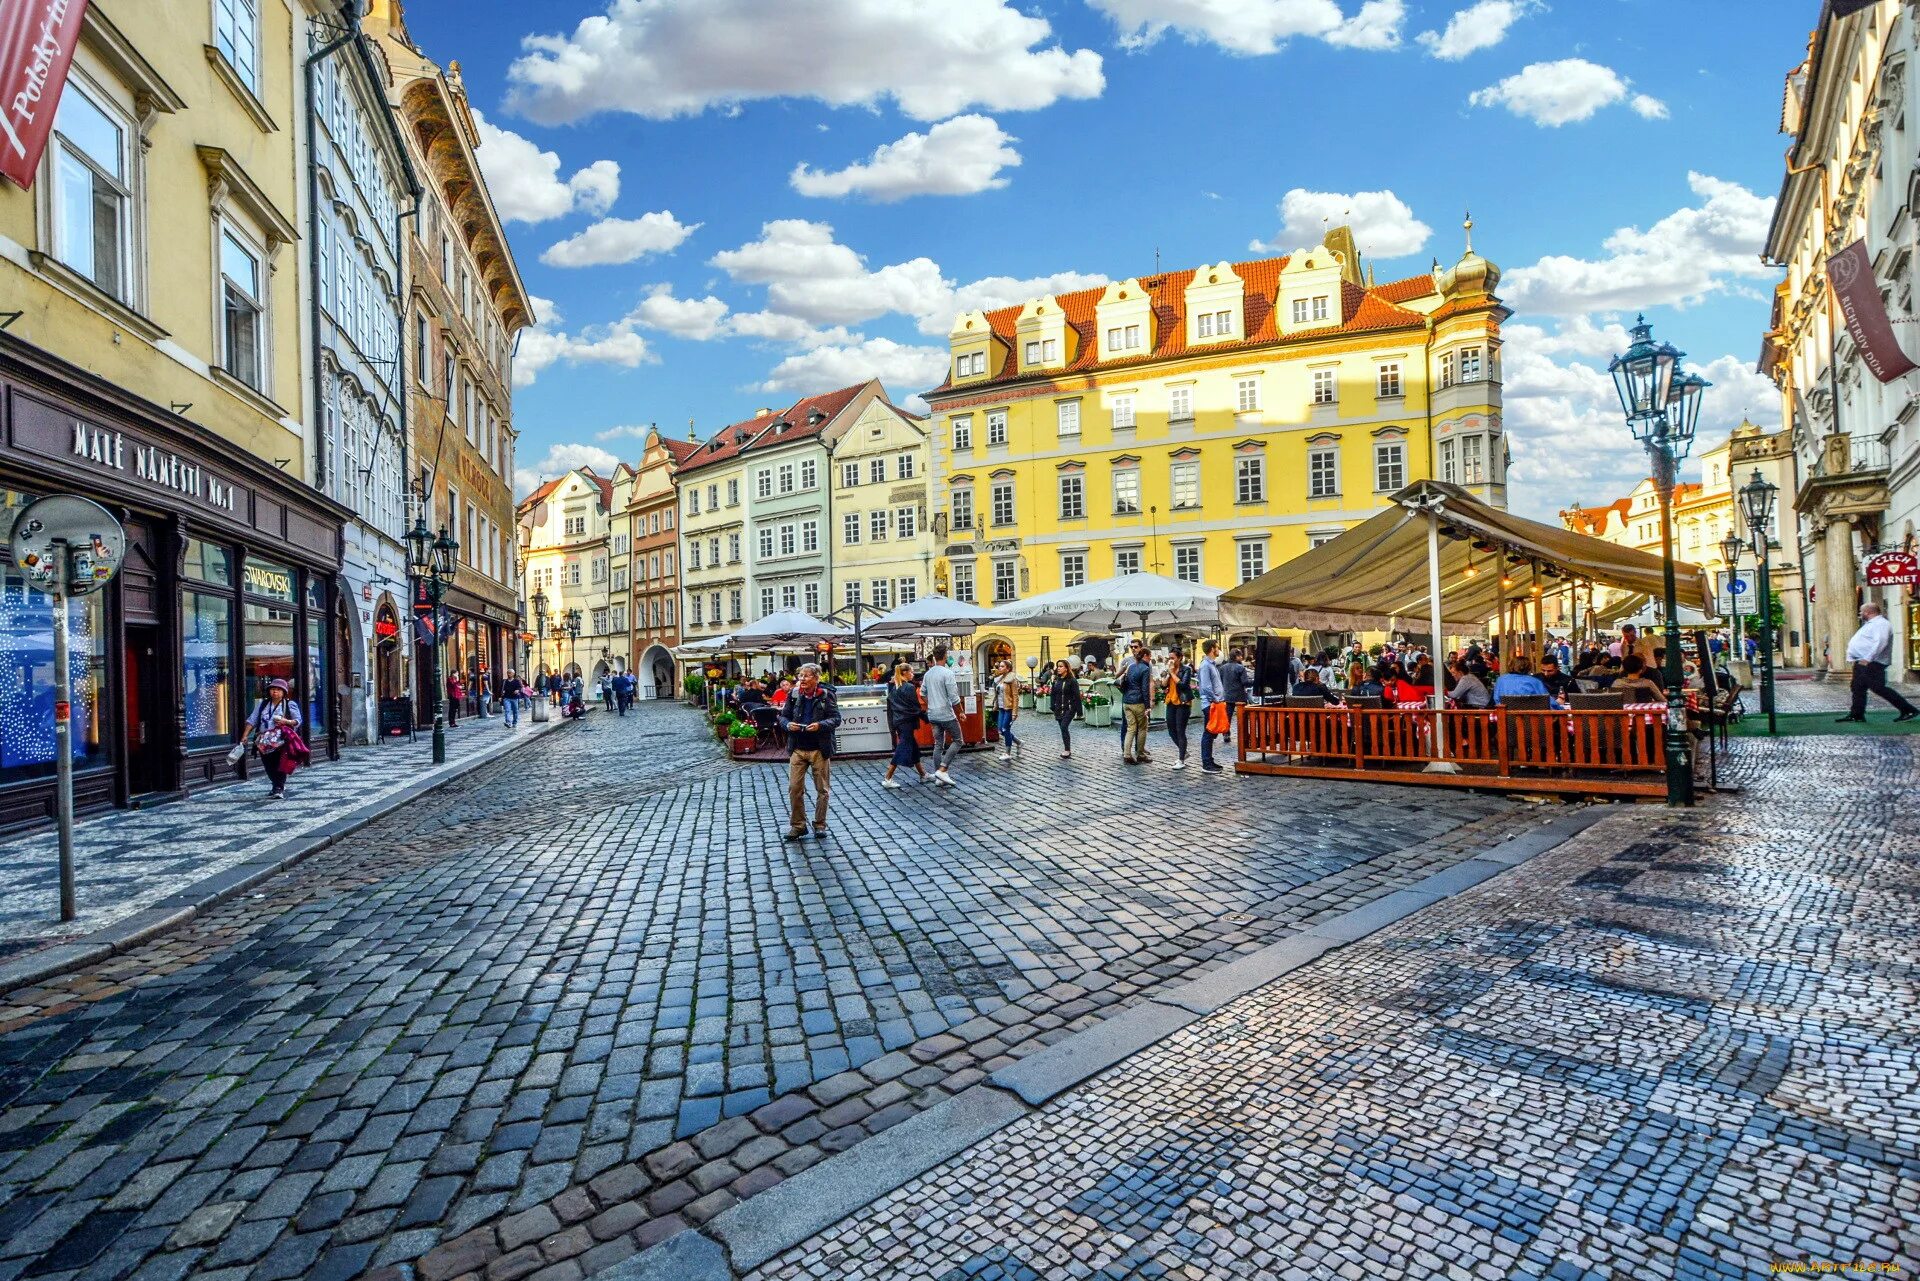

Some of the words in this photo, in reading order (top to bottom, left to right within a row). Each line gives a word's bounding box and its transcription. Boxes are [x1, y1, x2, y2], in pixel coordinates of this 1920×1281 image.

[12, 22, 61, 125] Polský
[74, 421, 124, 470] MALÉ
[136, 445, 201, 498] NÁMĚSTÍ
[1874, 553, 1912, 566] CZECH
[243, 564, 291, 593] SWAROVSKI
[1869, 574, 1918, 585] GARNET
[842, 716, 879, 725] YOTES
